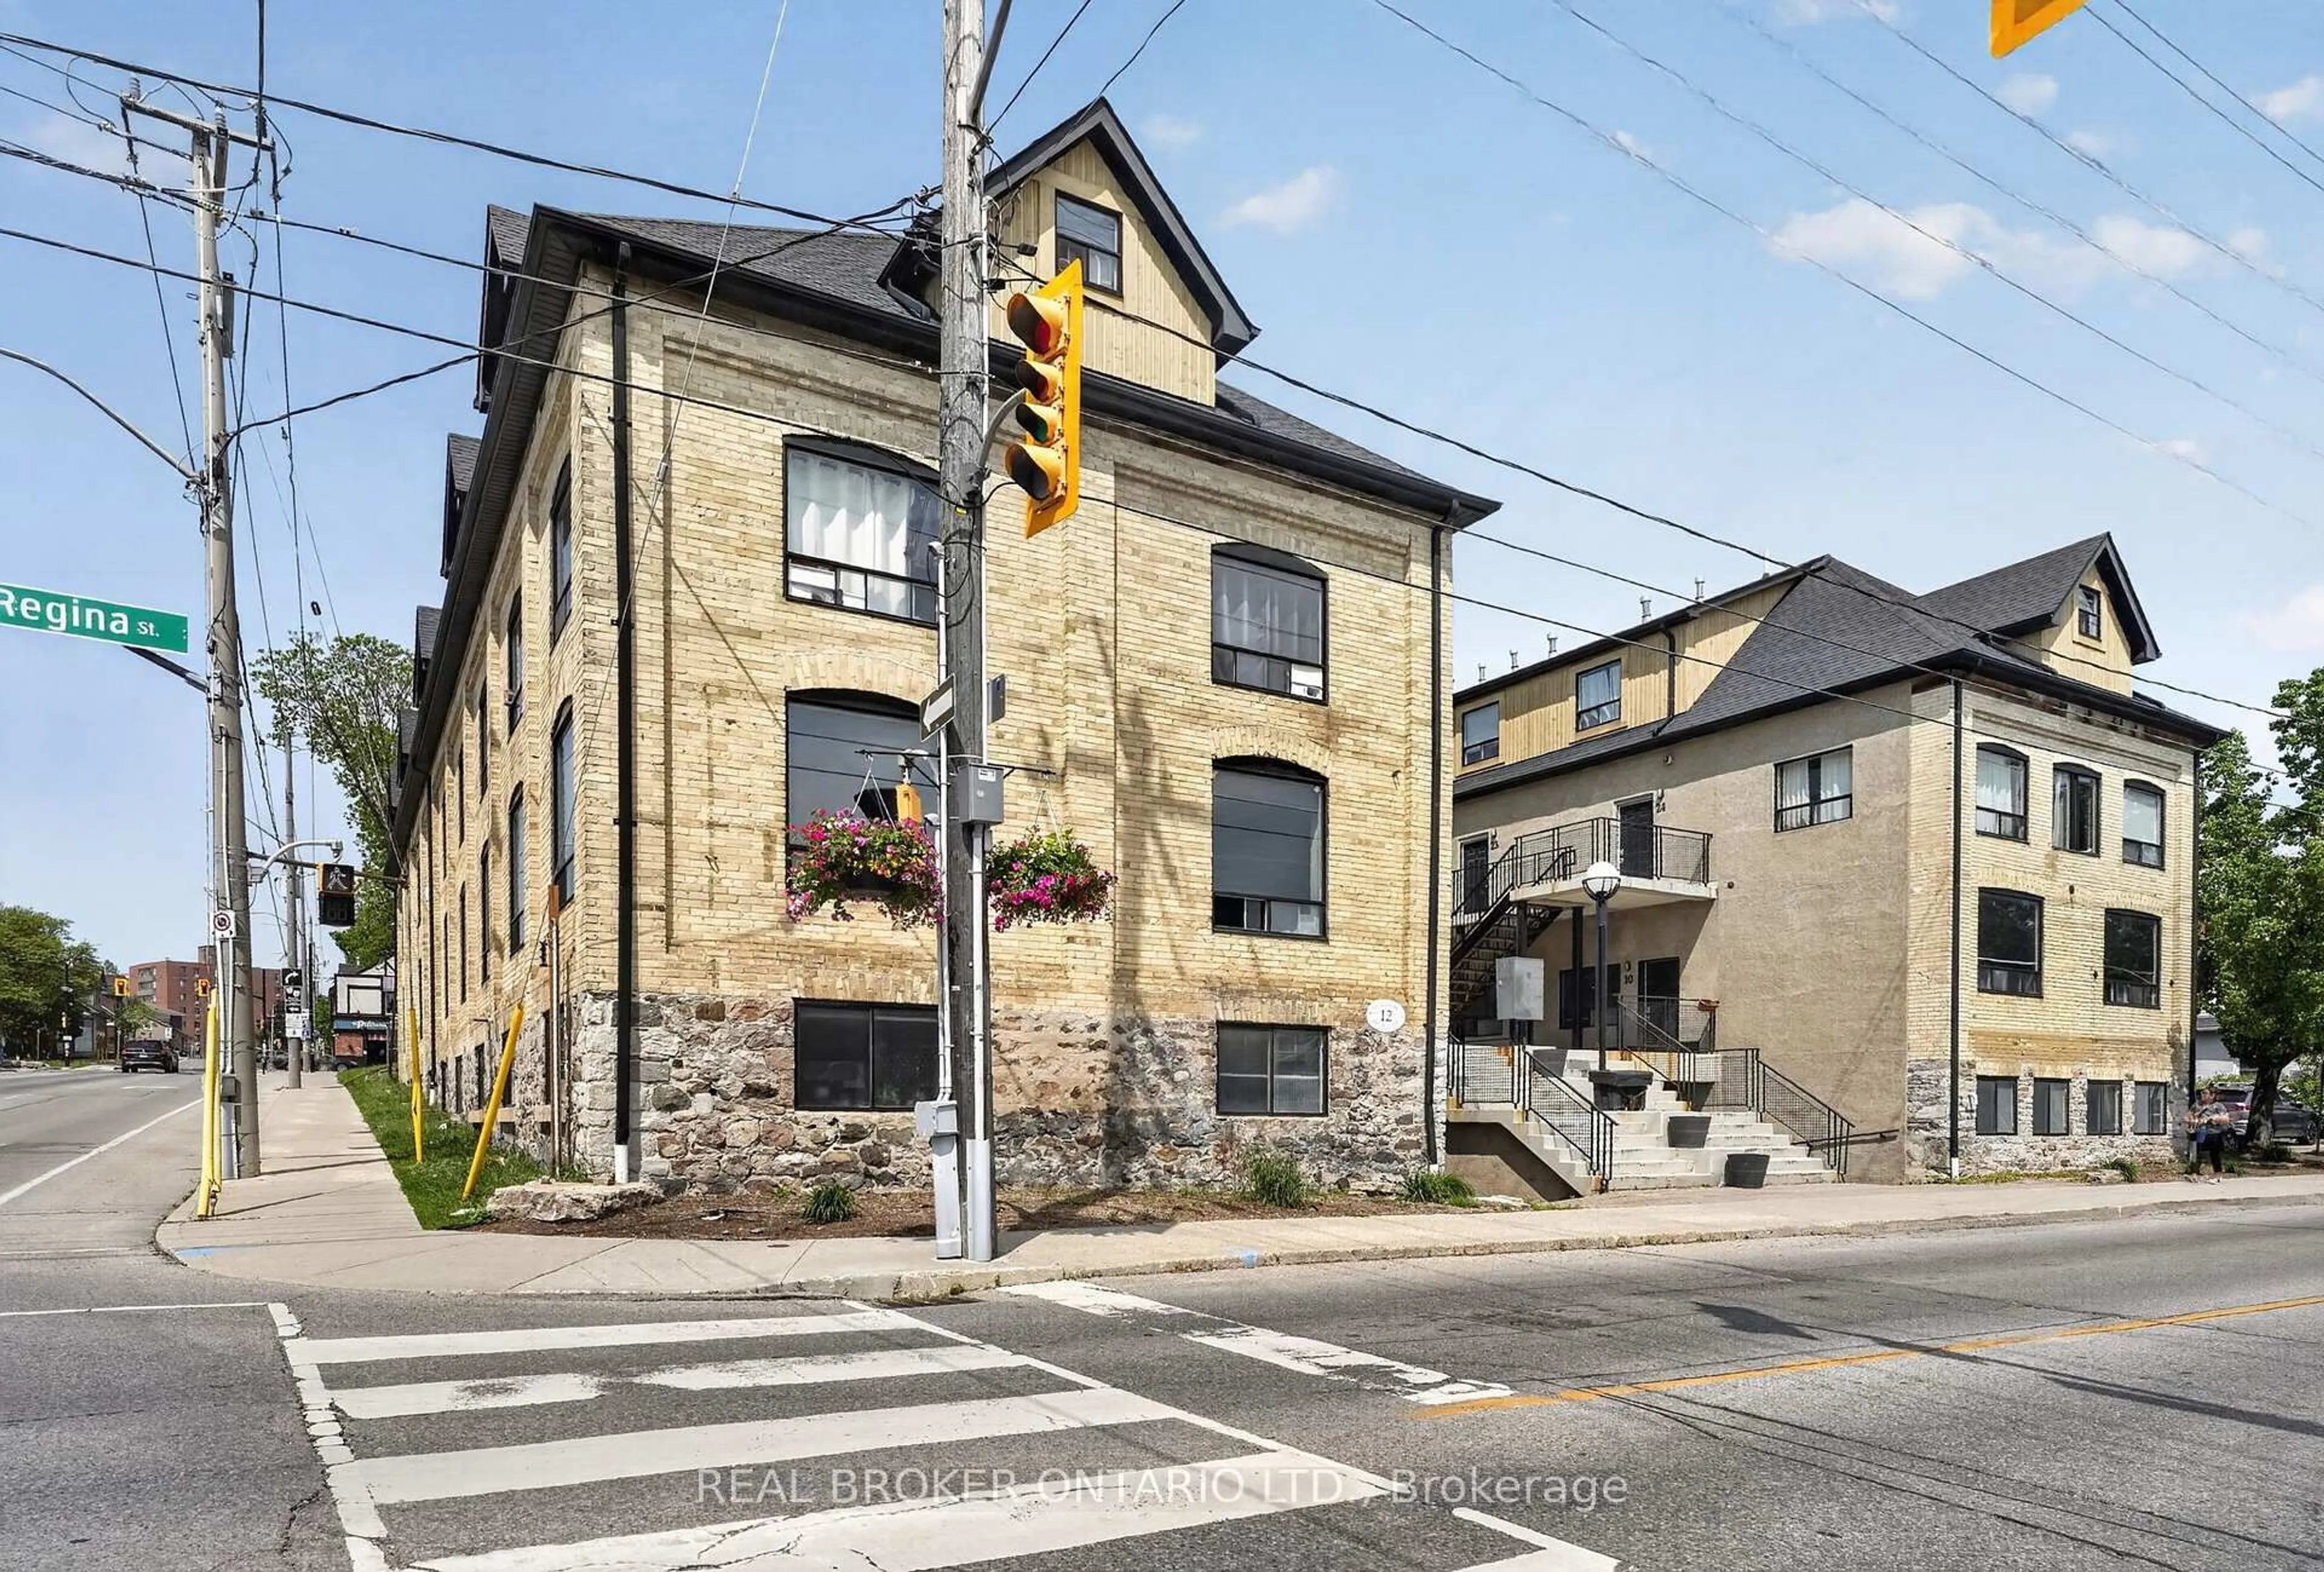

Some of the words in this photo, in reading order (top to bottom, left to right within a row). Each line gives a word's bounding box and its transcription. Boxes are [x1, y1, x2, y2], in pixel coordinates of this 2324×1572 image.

[0, 588, 129, 635] Regina
[136, 621, 159, 637] St.
[1381, 1009, 1393, 1022] 12
